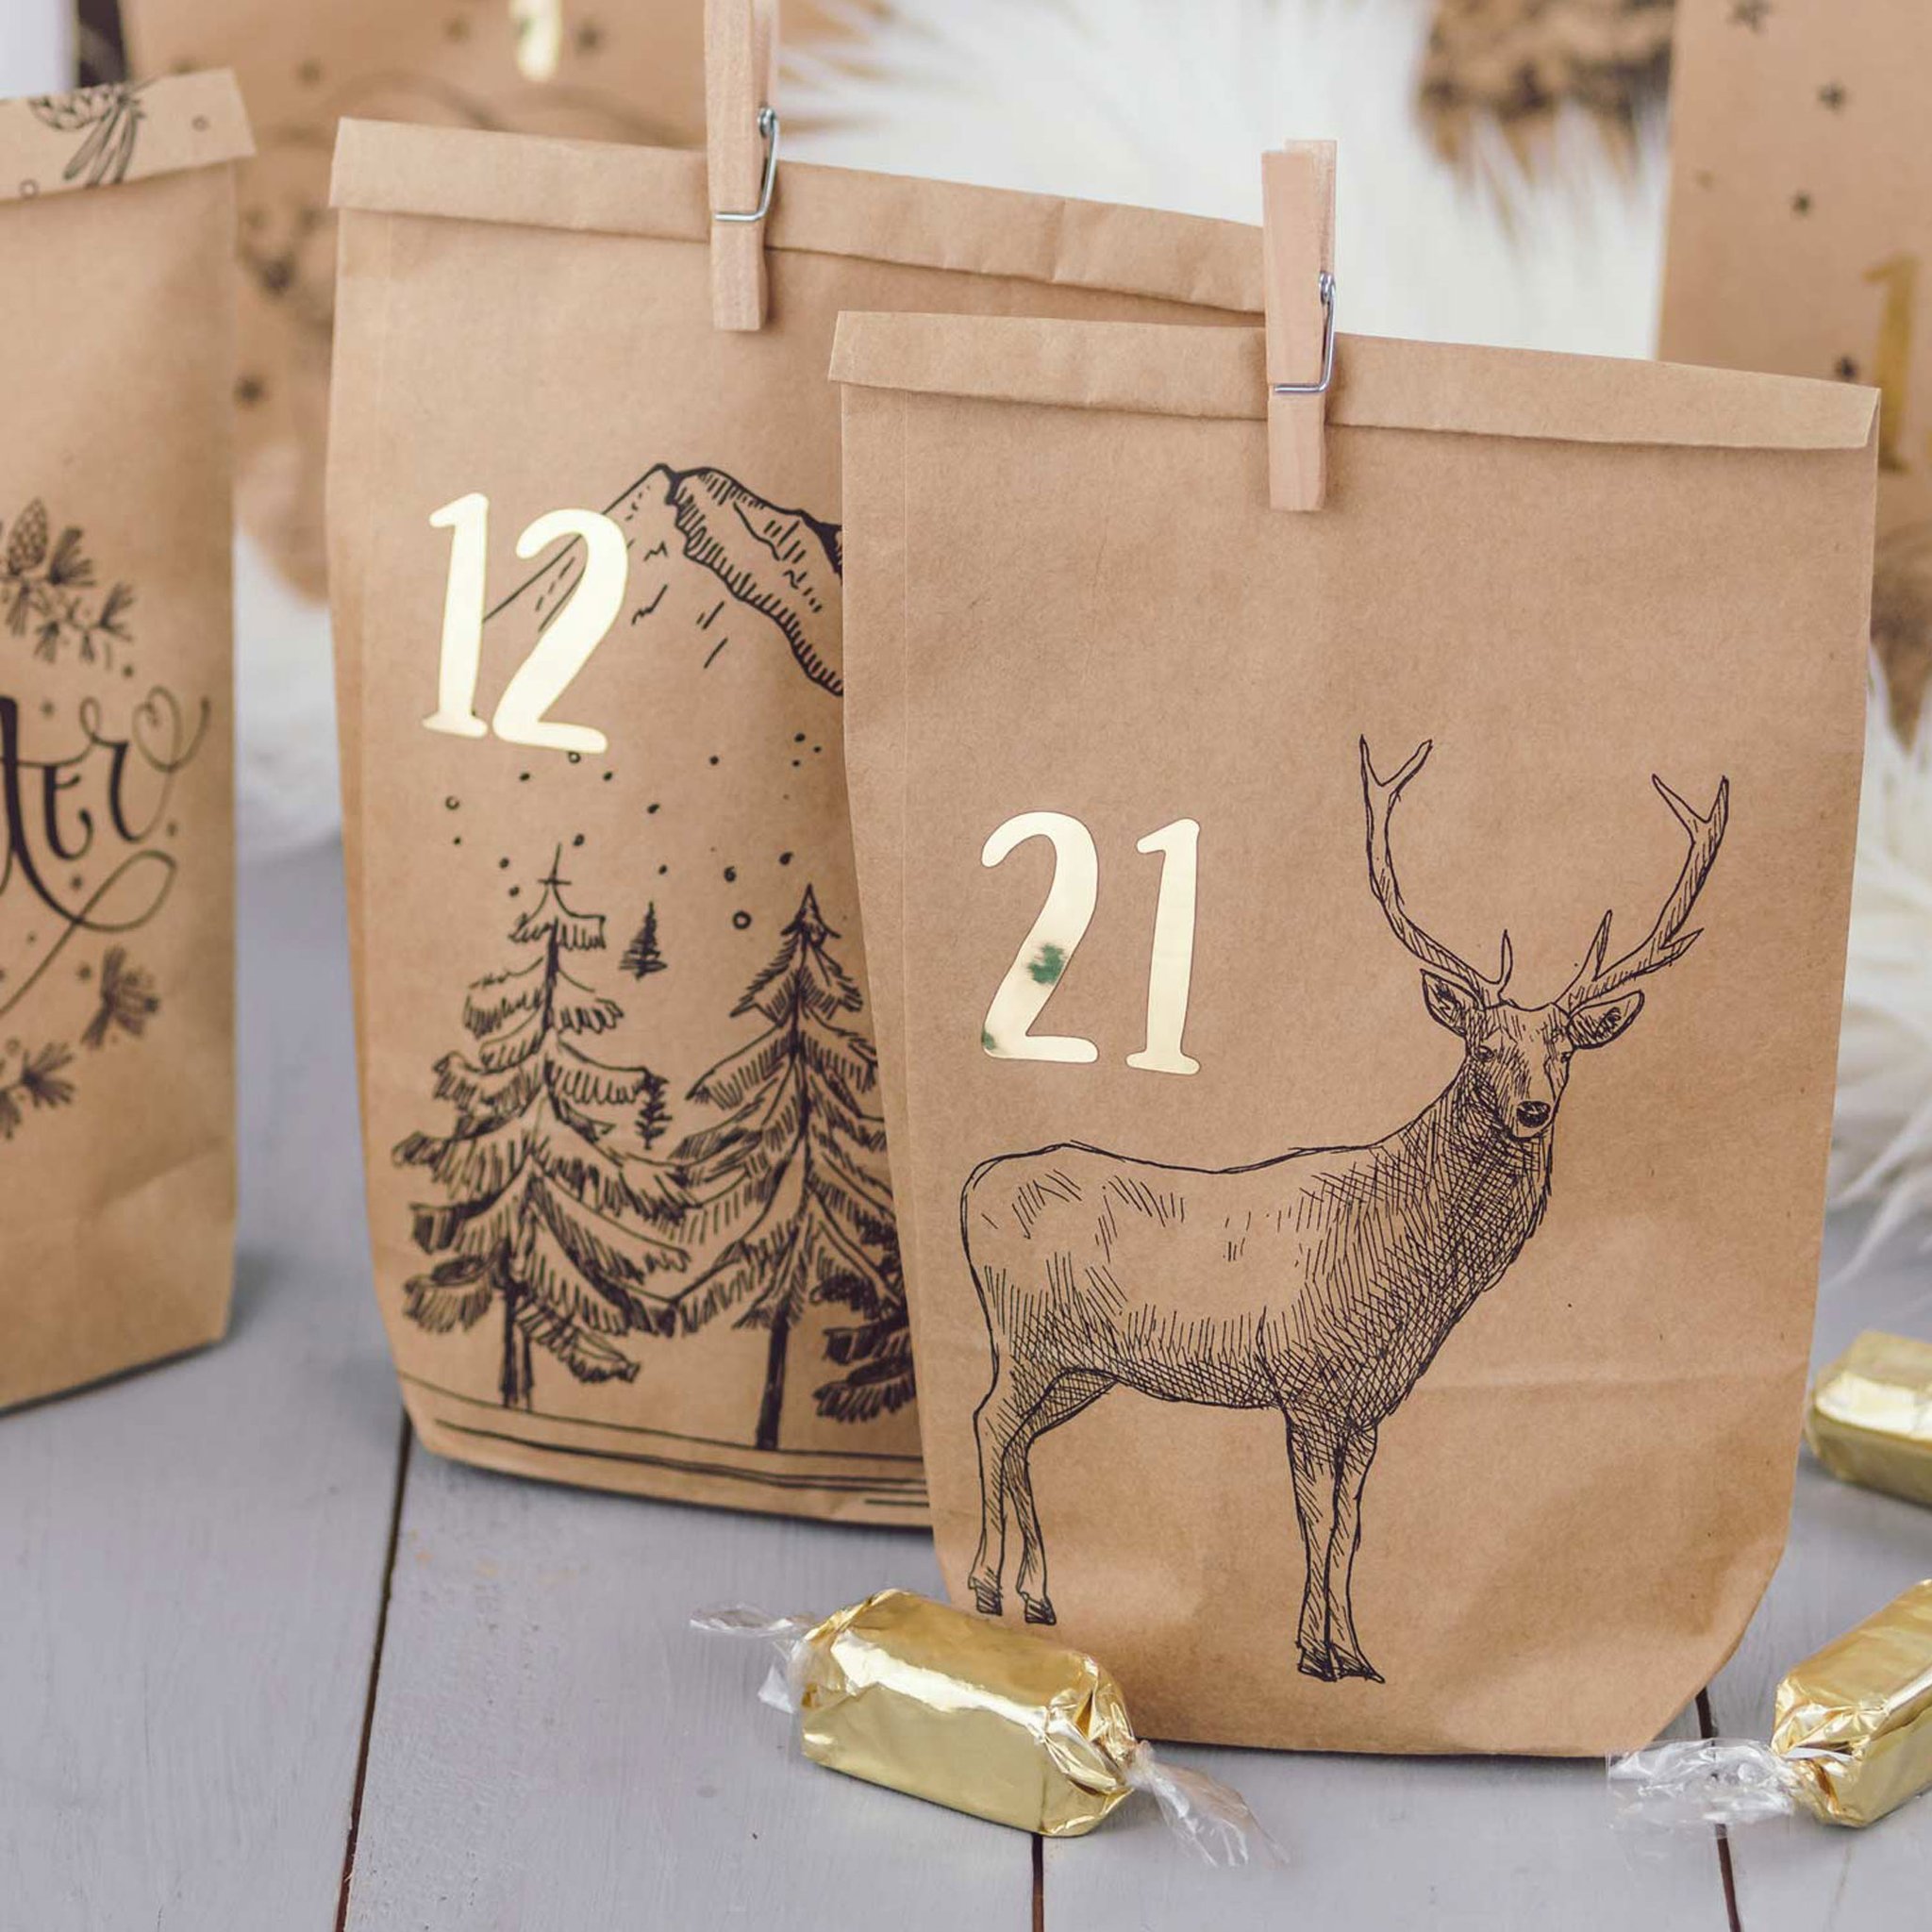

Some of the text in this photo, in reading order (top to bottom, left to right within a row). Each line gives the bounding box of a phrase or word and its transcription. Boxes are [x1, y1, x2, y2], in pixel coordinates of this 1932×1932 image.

[1860, 251, 1932, 475] 1
[422, 491, 628, 755] 12
[980, 810, 1202, 1075] 21
